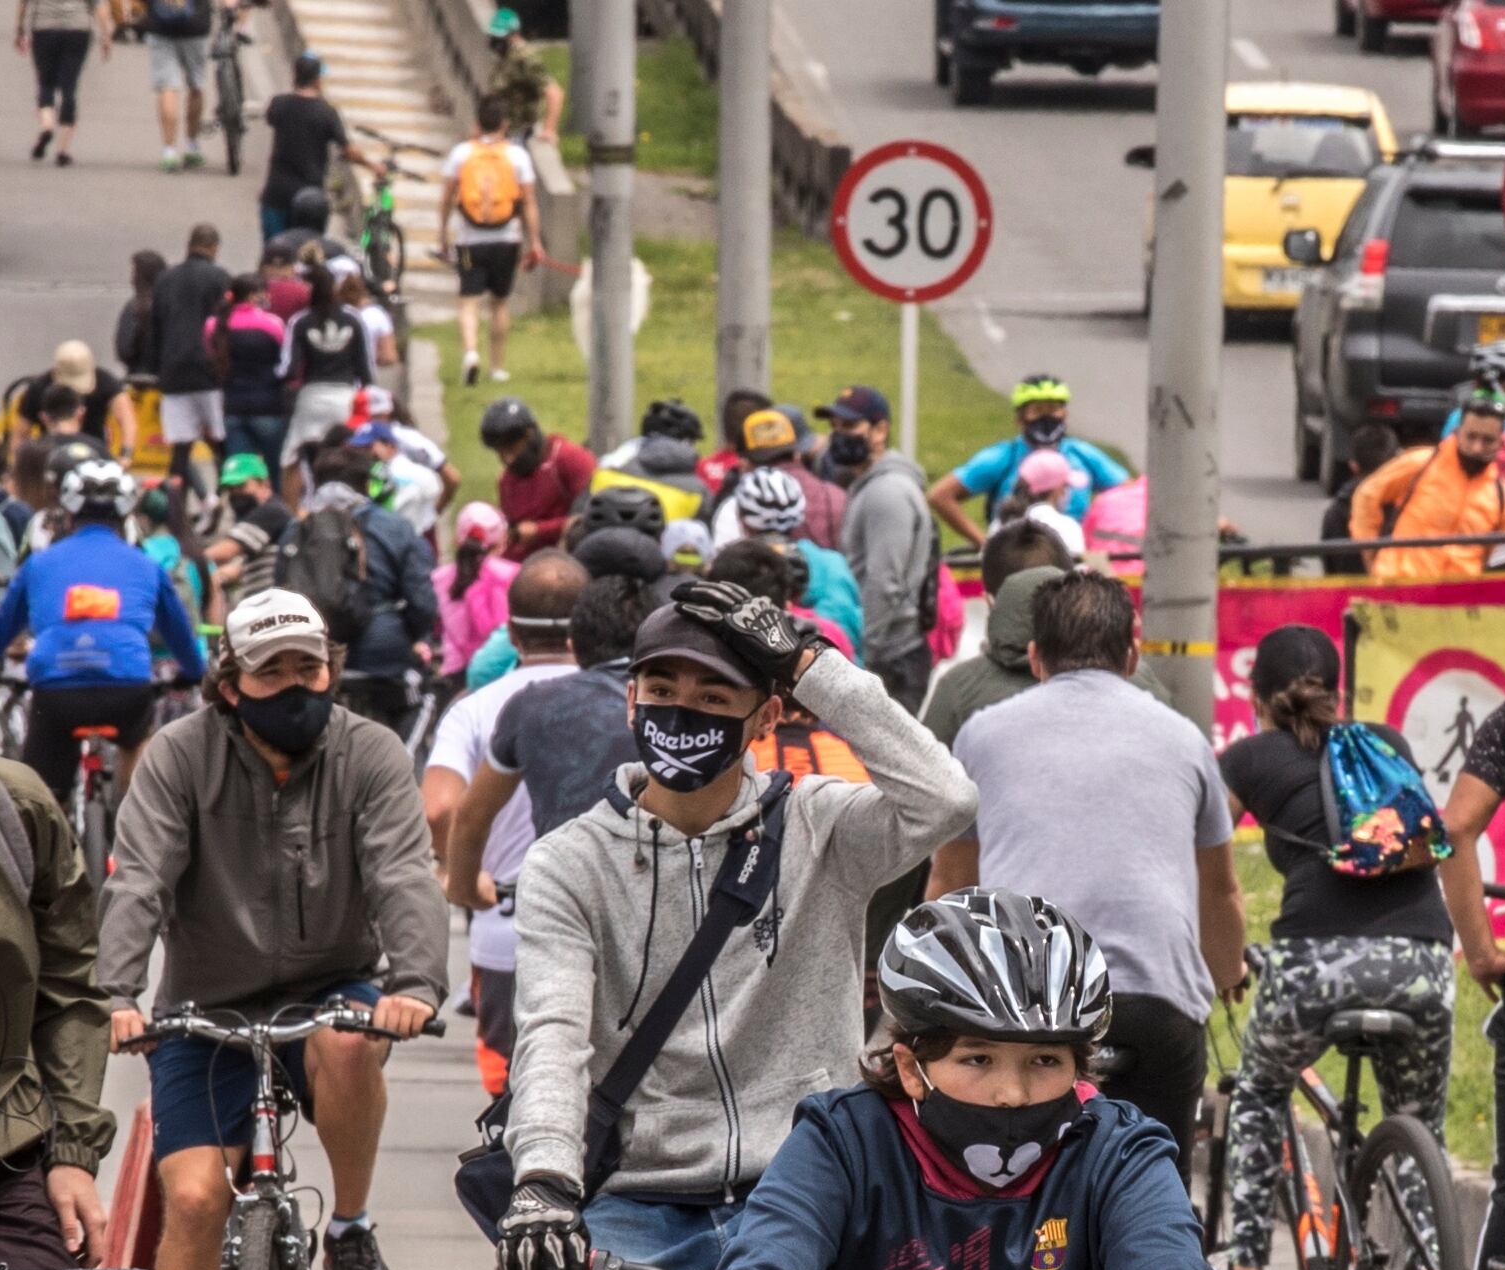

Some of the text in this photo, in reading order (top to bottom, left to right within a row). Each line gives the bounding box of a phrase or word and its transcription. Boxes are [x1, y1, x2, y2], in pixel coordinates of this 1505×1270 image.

[862, 187, 961, 259] 30
[644, 719, 725, 750] Reebok
[737, 845, 761, 884] adidas
